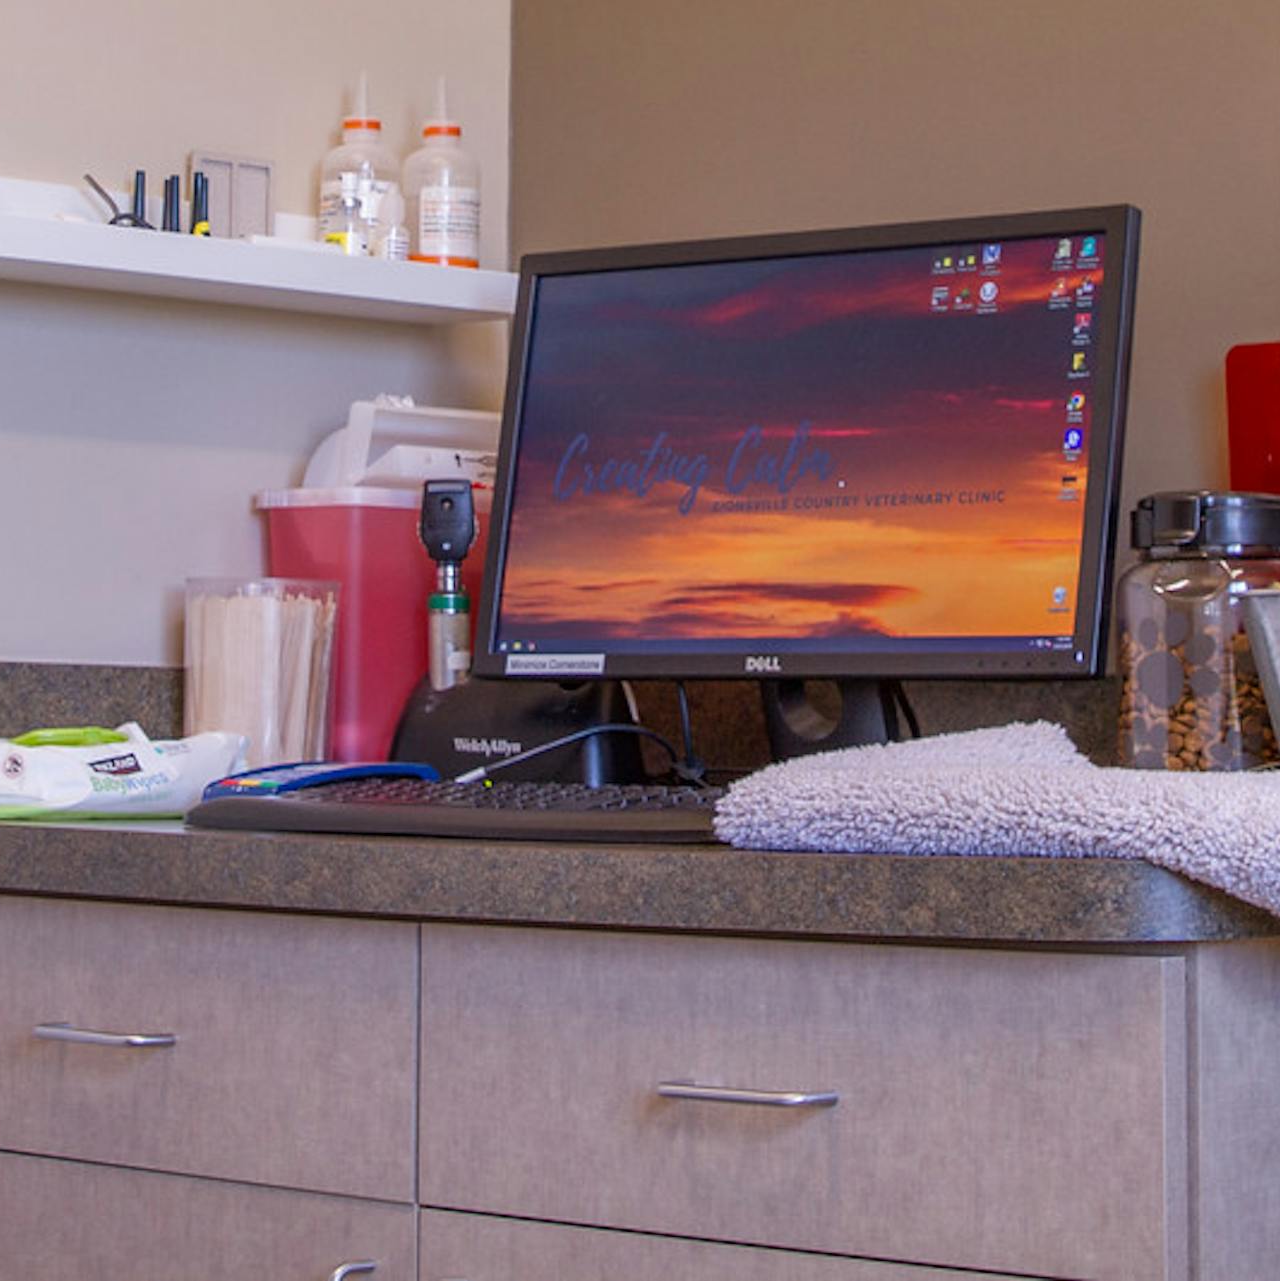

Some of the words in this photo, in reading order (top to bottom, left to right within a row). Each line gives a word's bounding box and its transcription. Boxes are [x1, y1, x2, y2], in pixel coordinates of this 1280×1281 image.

[553, 432, 709, 516] Creating
[724, 419, 837, 495] Calm
[793, 496, 858, 509] COUNTRY
[864, 493, 952, 507] VETERINARY
[957, 491, 1005, 504] CLINIC
[745, 656, 781, 672] DELL
